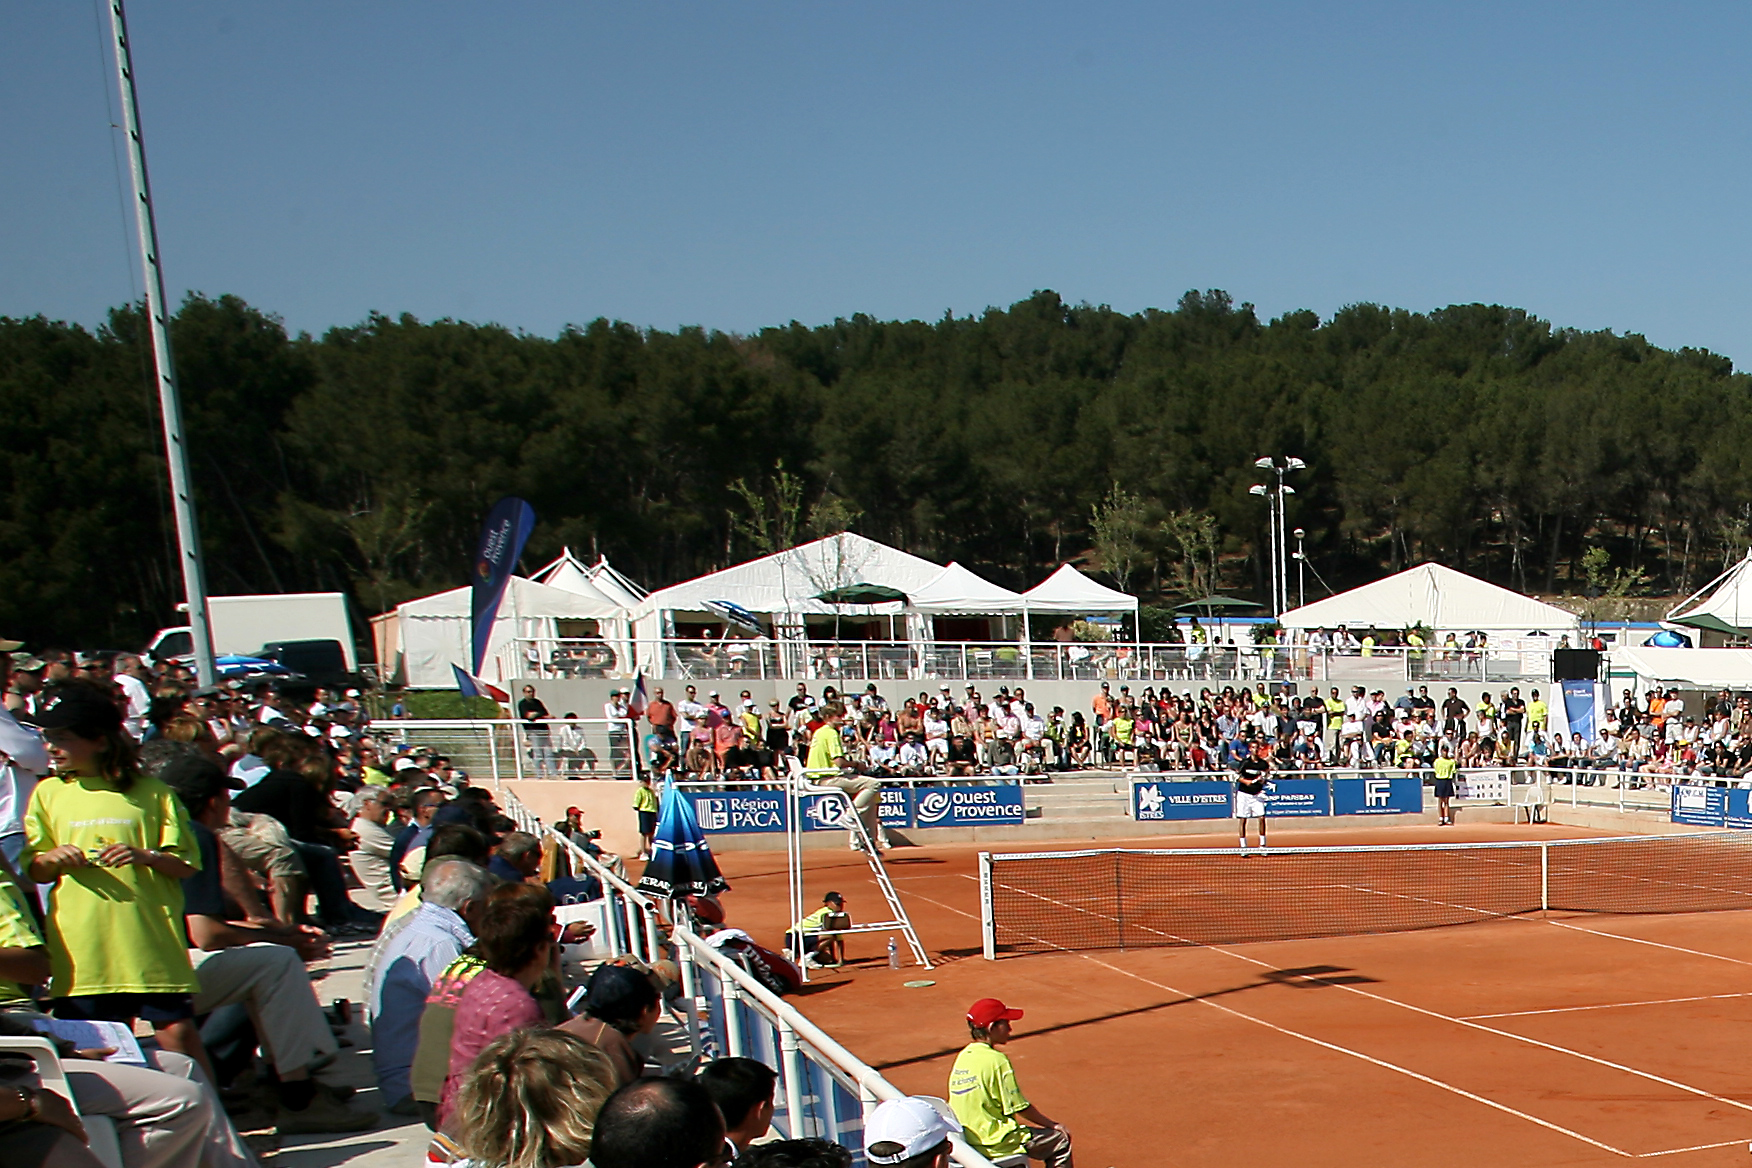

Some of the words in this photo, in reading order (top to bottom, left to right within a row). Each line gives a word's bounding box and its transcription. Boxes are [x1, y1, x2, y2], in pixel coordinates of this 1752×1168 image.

[880, 791, 906, 803] SEIL
[952, 790, 997, 804] Ouest
[1168, 795, 1191, 804] VILLE
[1192, 794, 1228, 803] D'ISTRES
[731, 797, 779, 814] Région
[878, 805, 907, 817] ERAL
[953, 804, 1022, 818] Provence
[732, 811, 782, 827] PACA
[1139, 810, 1165, 819] ISTRES
